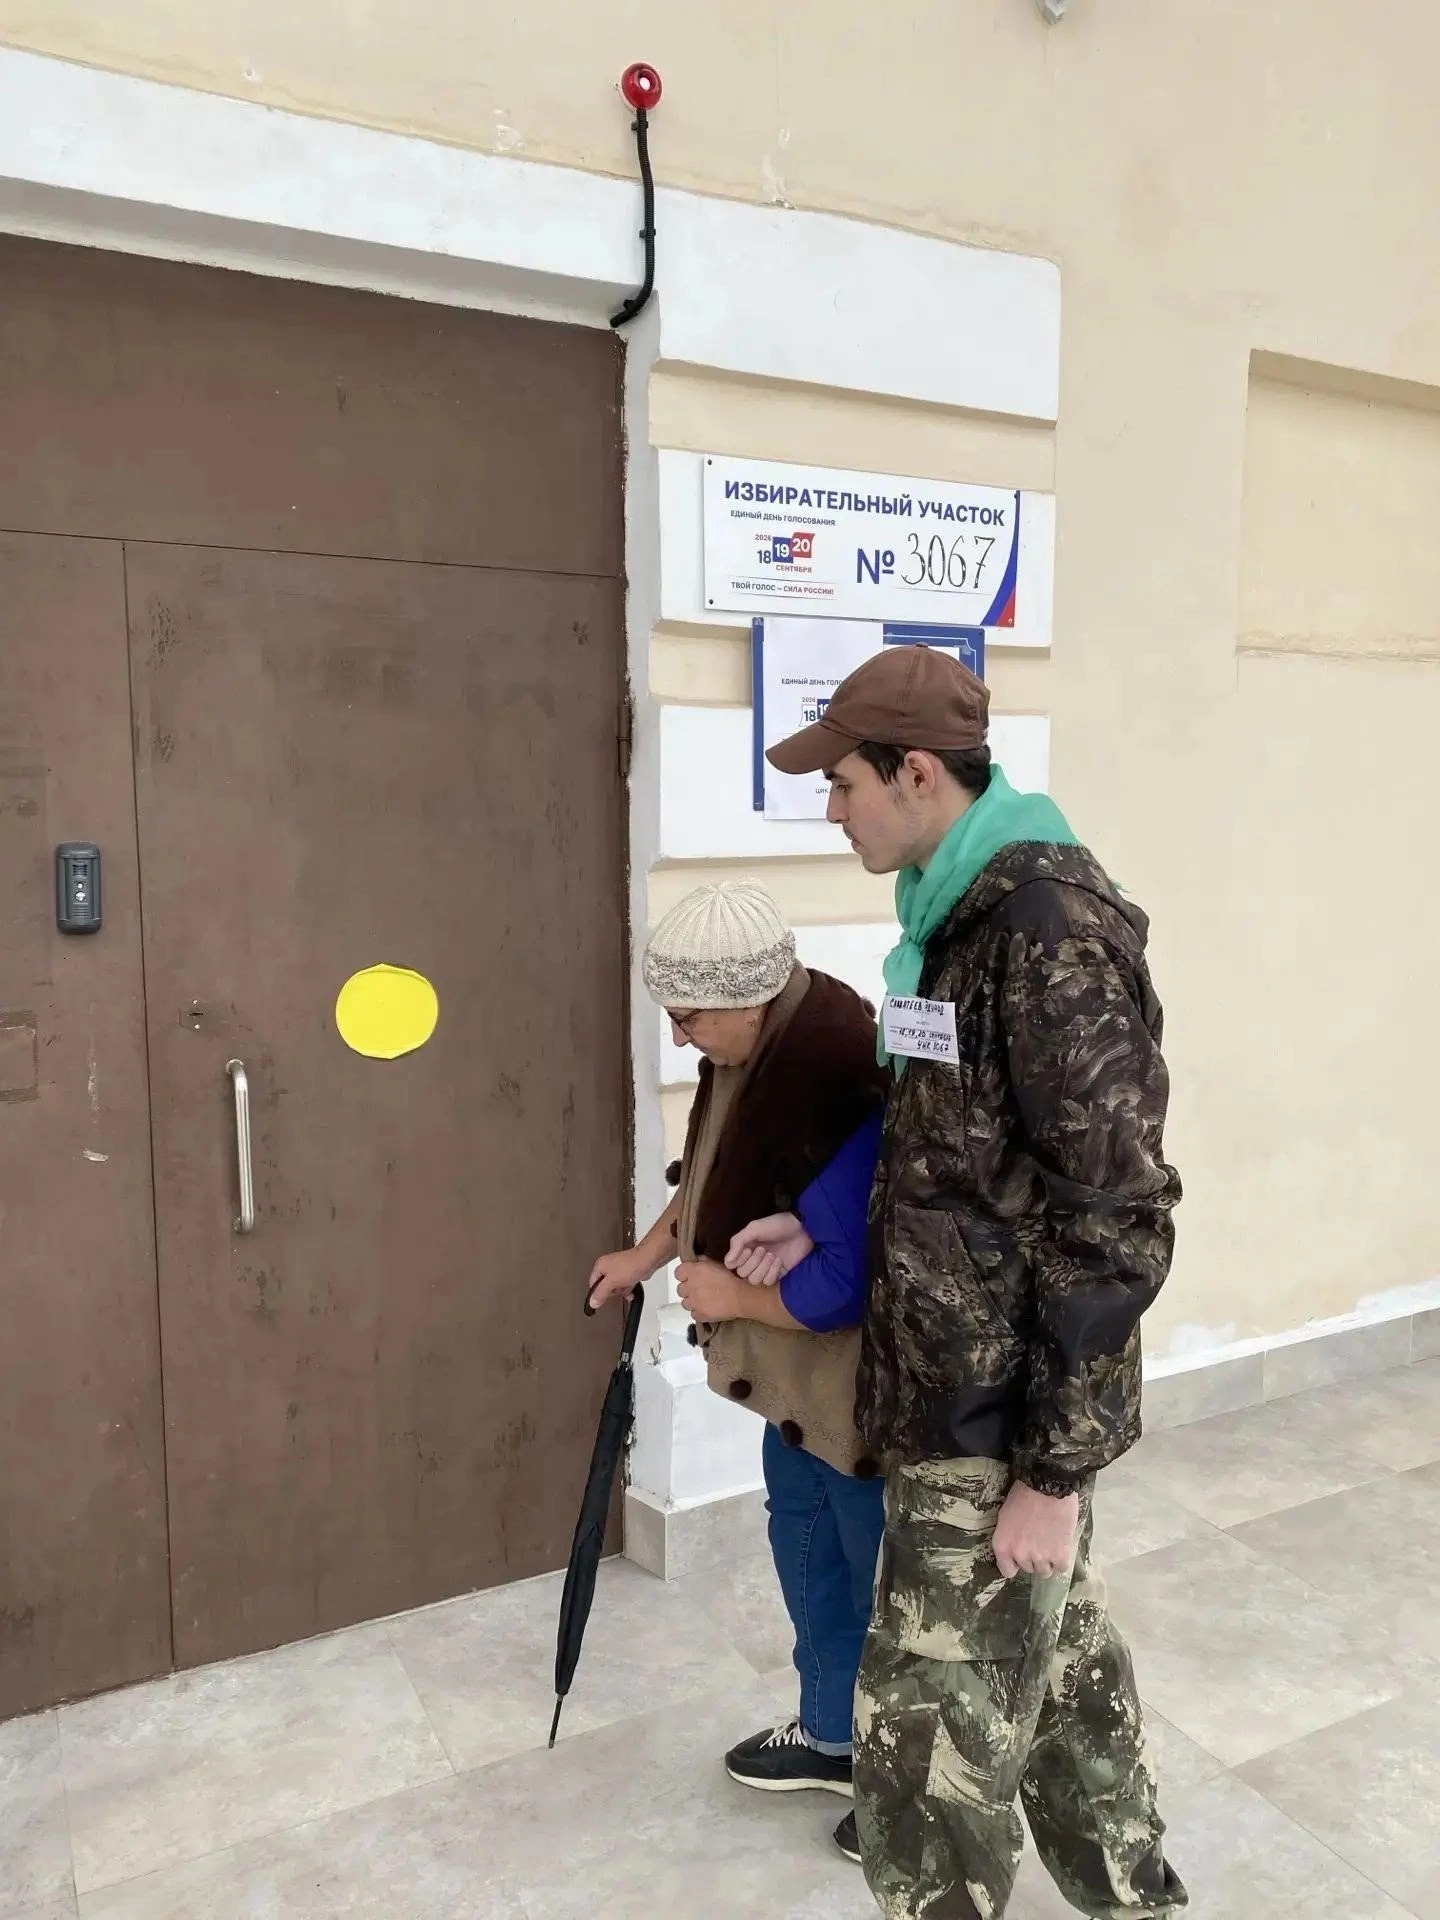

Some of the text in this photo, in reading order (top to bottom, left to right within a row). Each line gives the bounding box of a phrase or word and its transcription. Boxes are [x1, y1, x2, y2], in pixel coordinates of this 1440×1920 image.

[725, 480, 1005, 527] ИЗБИРАТЕЛЬНЫЙ УЧАСТОК
[730, 509, 836, 526] ЕДИНЫЙ ДЕНЬ ГОЛОСОВАНИЯ
[757, 538, 811, 564] 18 19 20
[856, 532, 995, 589] № 3067
[776, 564, 812, 573] СЕНТЯБРЯ
[731, 581, 751, 589] ТВОЙ
[752, 583, 776, 591] ГОЛОС
[783, 585, 803, 593] СИЛА
[804, 587, 834, 595] РОССИИ!
[781, 677, 808, 685] ЕДИНЫЙ
[804, 710, 816, 722] 18
